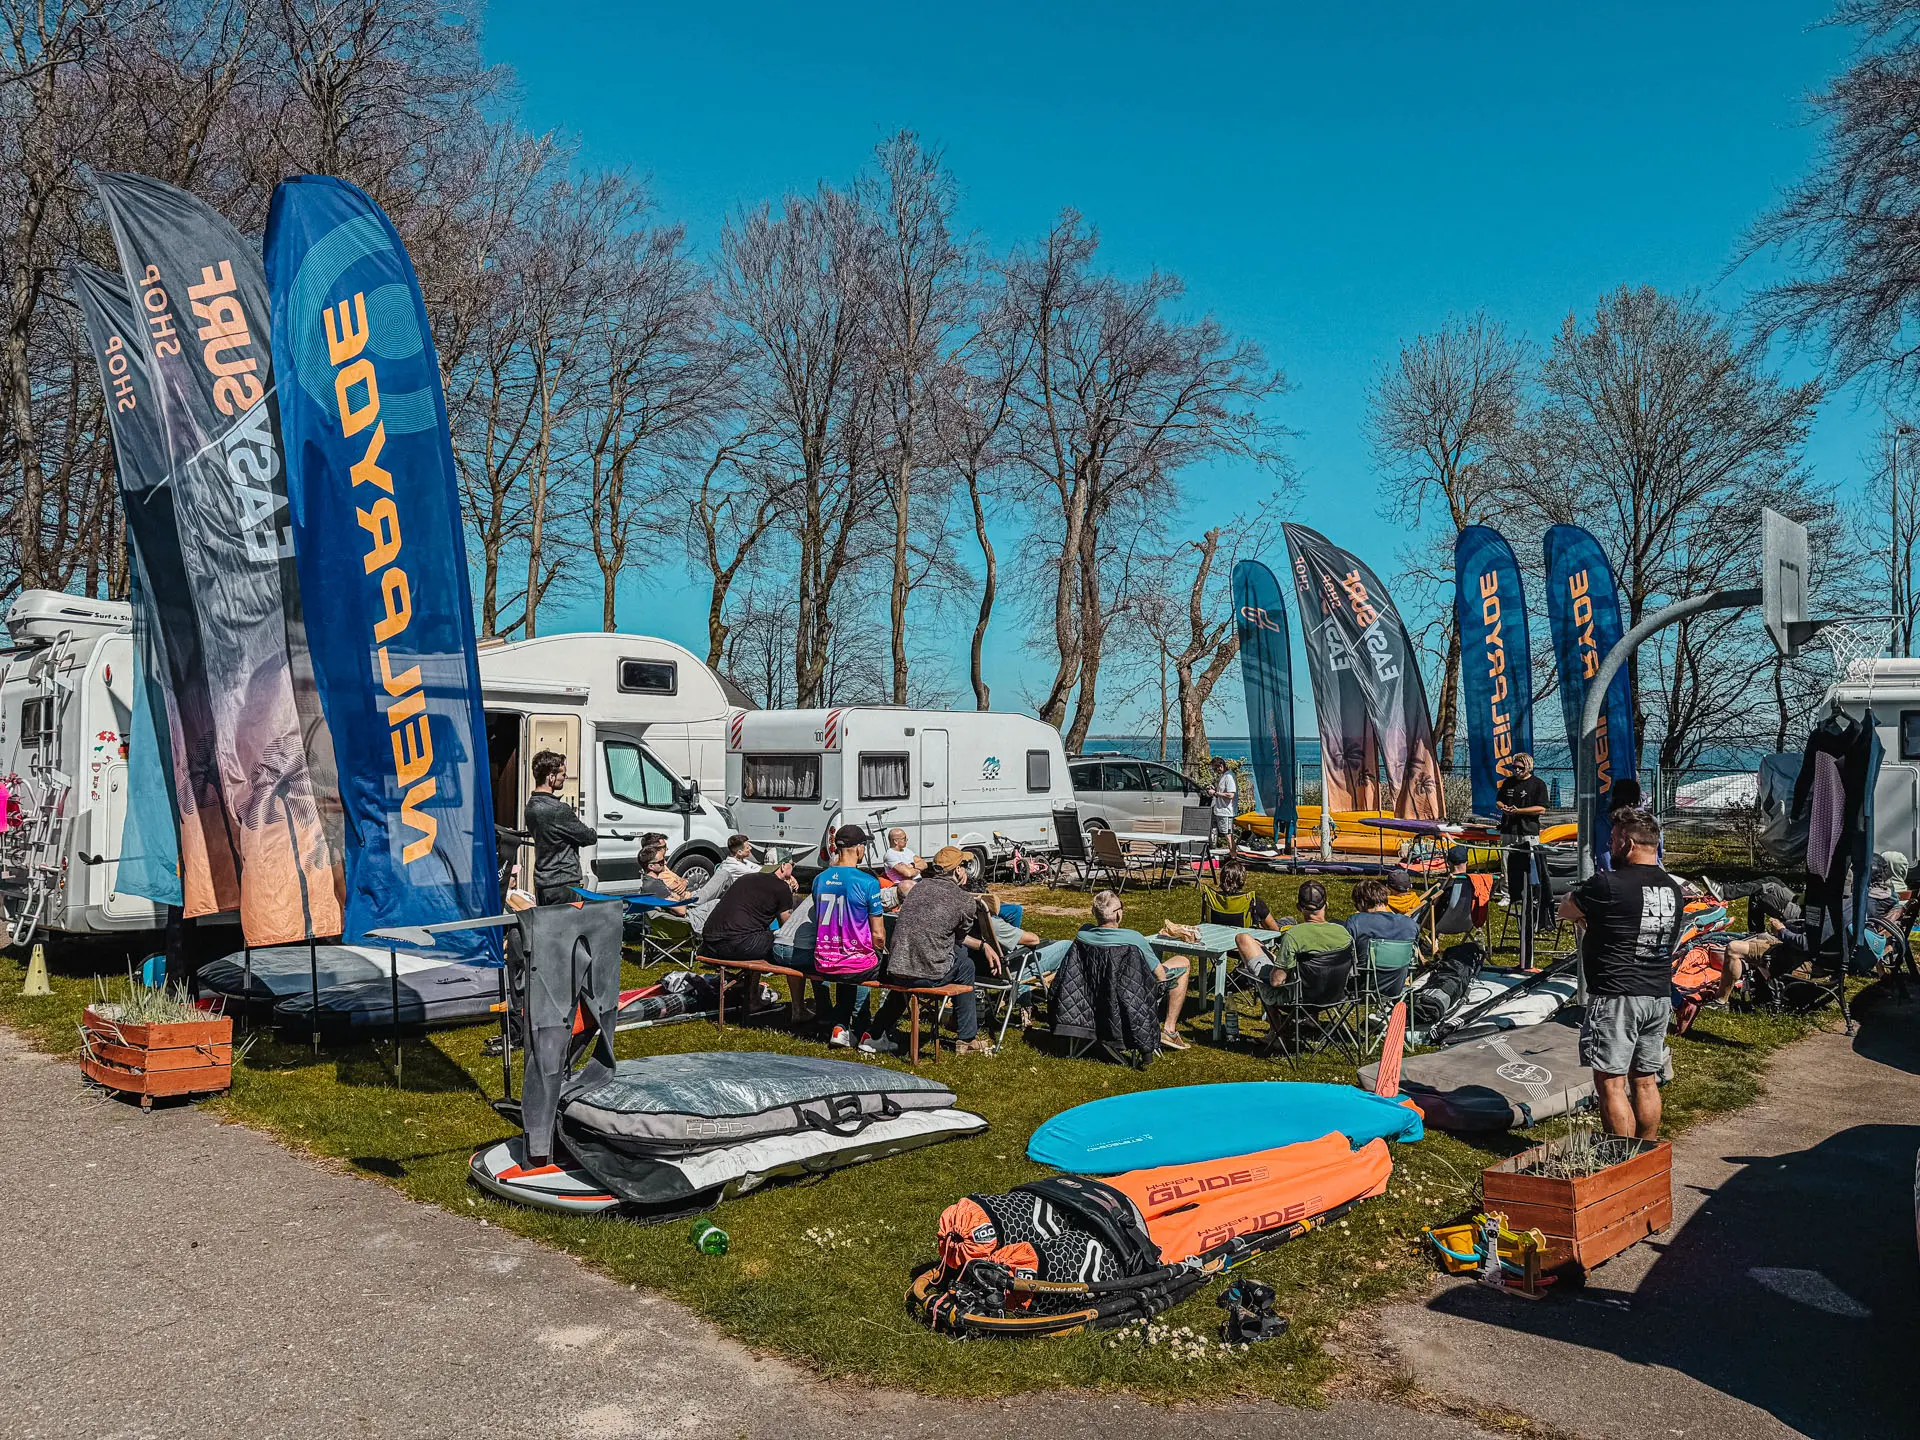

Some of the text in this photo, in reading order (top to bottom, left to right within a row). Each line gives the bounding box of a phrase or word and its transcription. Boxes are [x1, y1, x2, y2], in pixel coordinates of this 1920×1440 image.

[820, 893, 845, 927] 71
[1642, 886, 1676, 916] NO
[974, 1227, 996, 1239] 10.0
